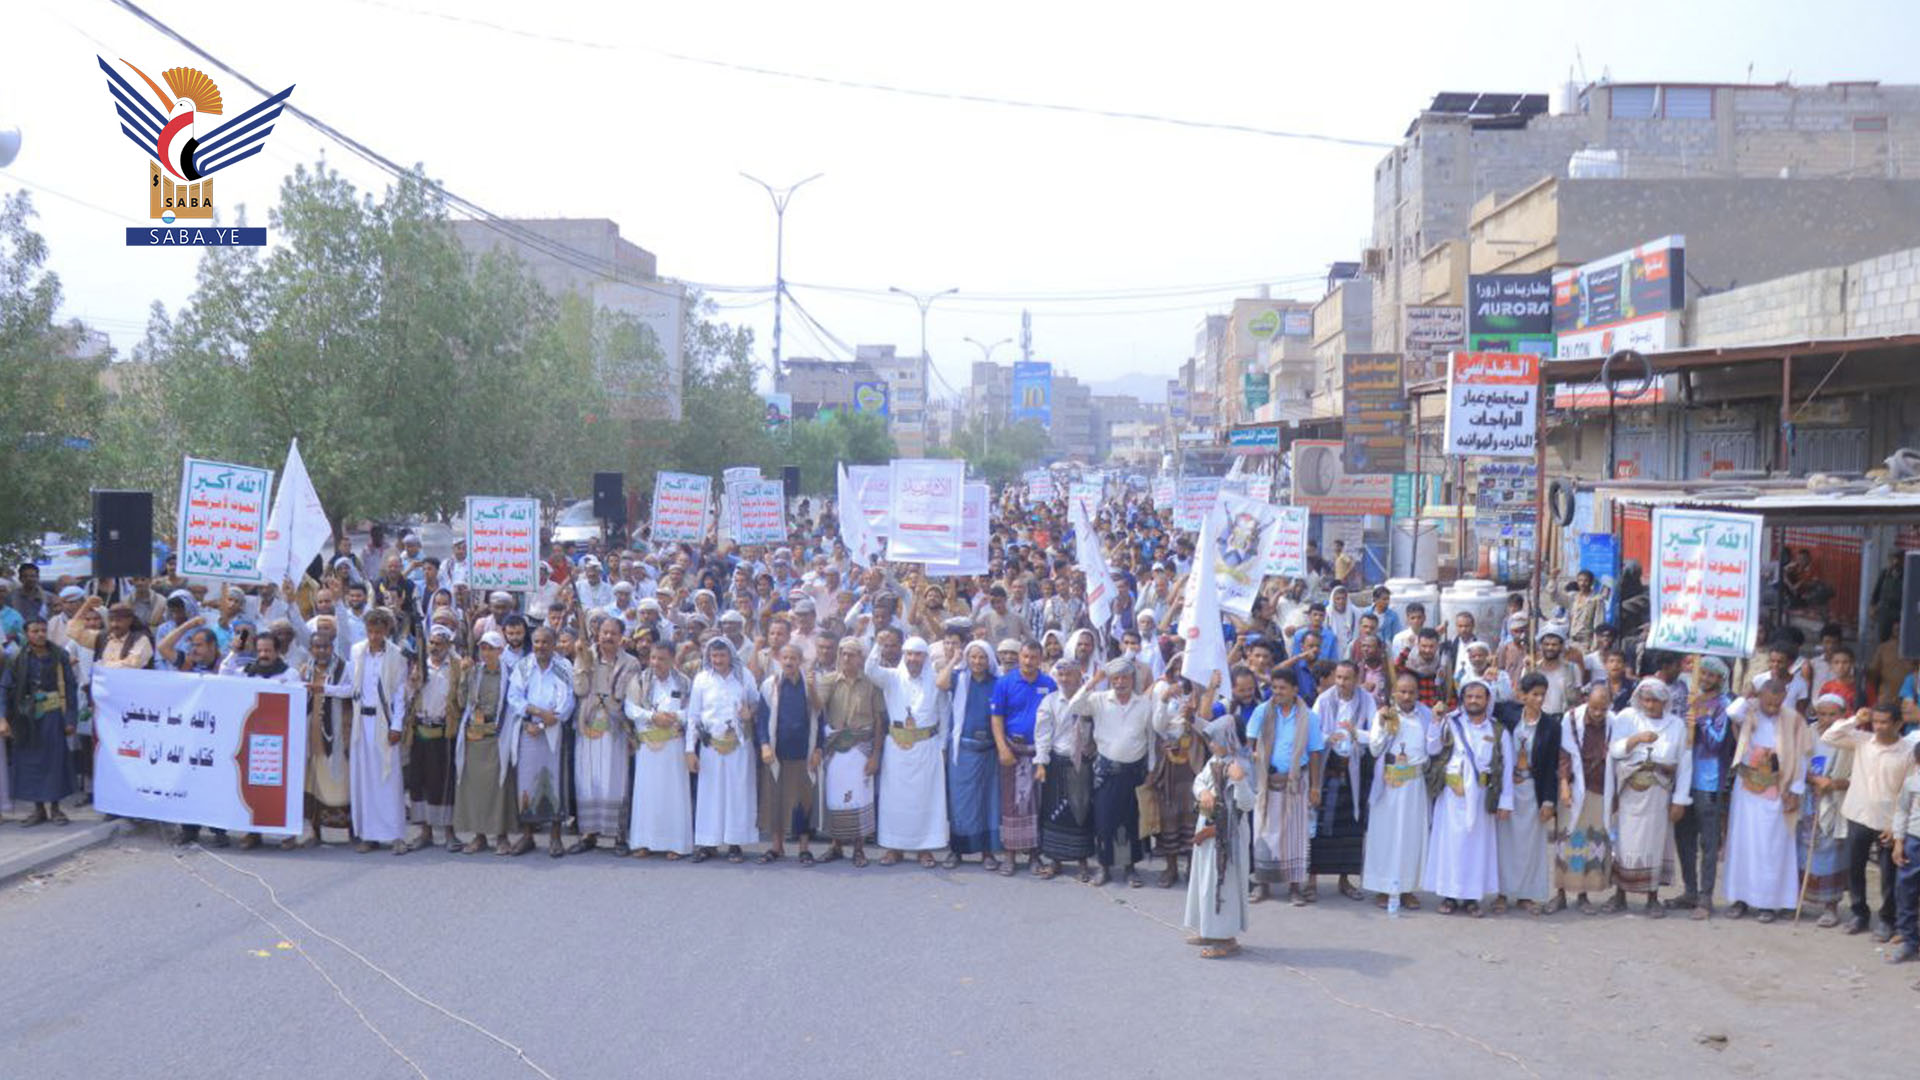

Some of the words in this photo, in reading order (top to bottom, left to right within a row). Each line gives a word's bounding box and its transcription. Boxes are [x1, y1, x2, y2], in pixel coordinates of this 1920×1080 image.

[1503, 281, 1550, 298] بطاريات
[1478, 302, 1550, 316] AURORA
[1455, 357, 1529, 382] القدسي
[236, 475, 262, 493] الله
[231, 500, 258, 513] الموت
[229, 520, 258, 533] الموت
[1716, 527, 1748, 550] الله
[226, 554, 257, 572] النصر
[1708, 559, 1747, 575] الموت
[1705, 584, 1746, 599] الموت
[1703, 627, 1743, 649] النصر
[167, 706, 182, 725] ما
[190, 710, 216, 734] والله
[167, 744, 184, 763] الله
[189, 747, 214, 770] كتاب
